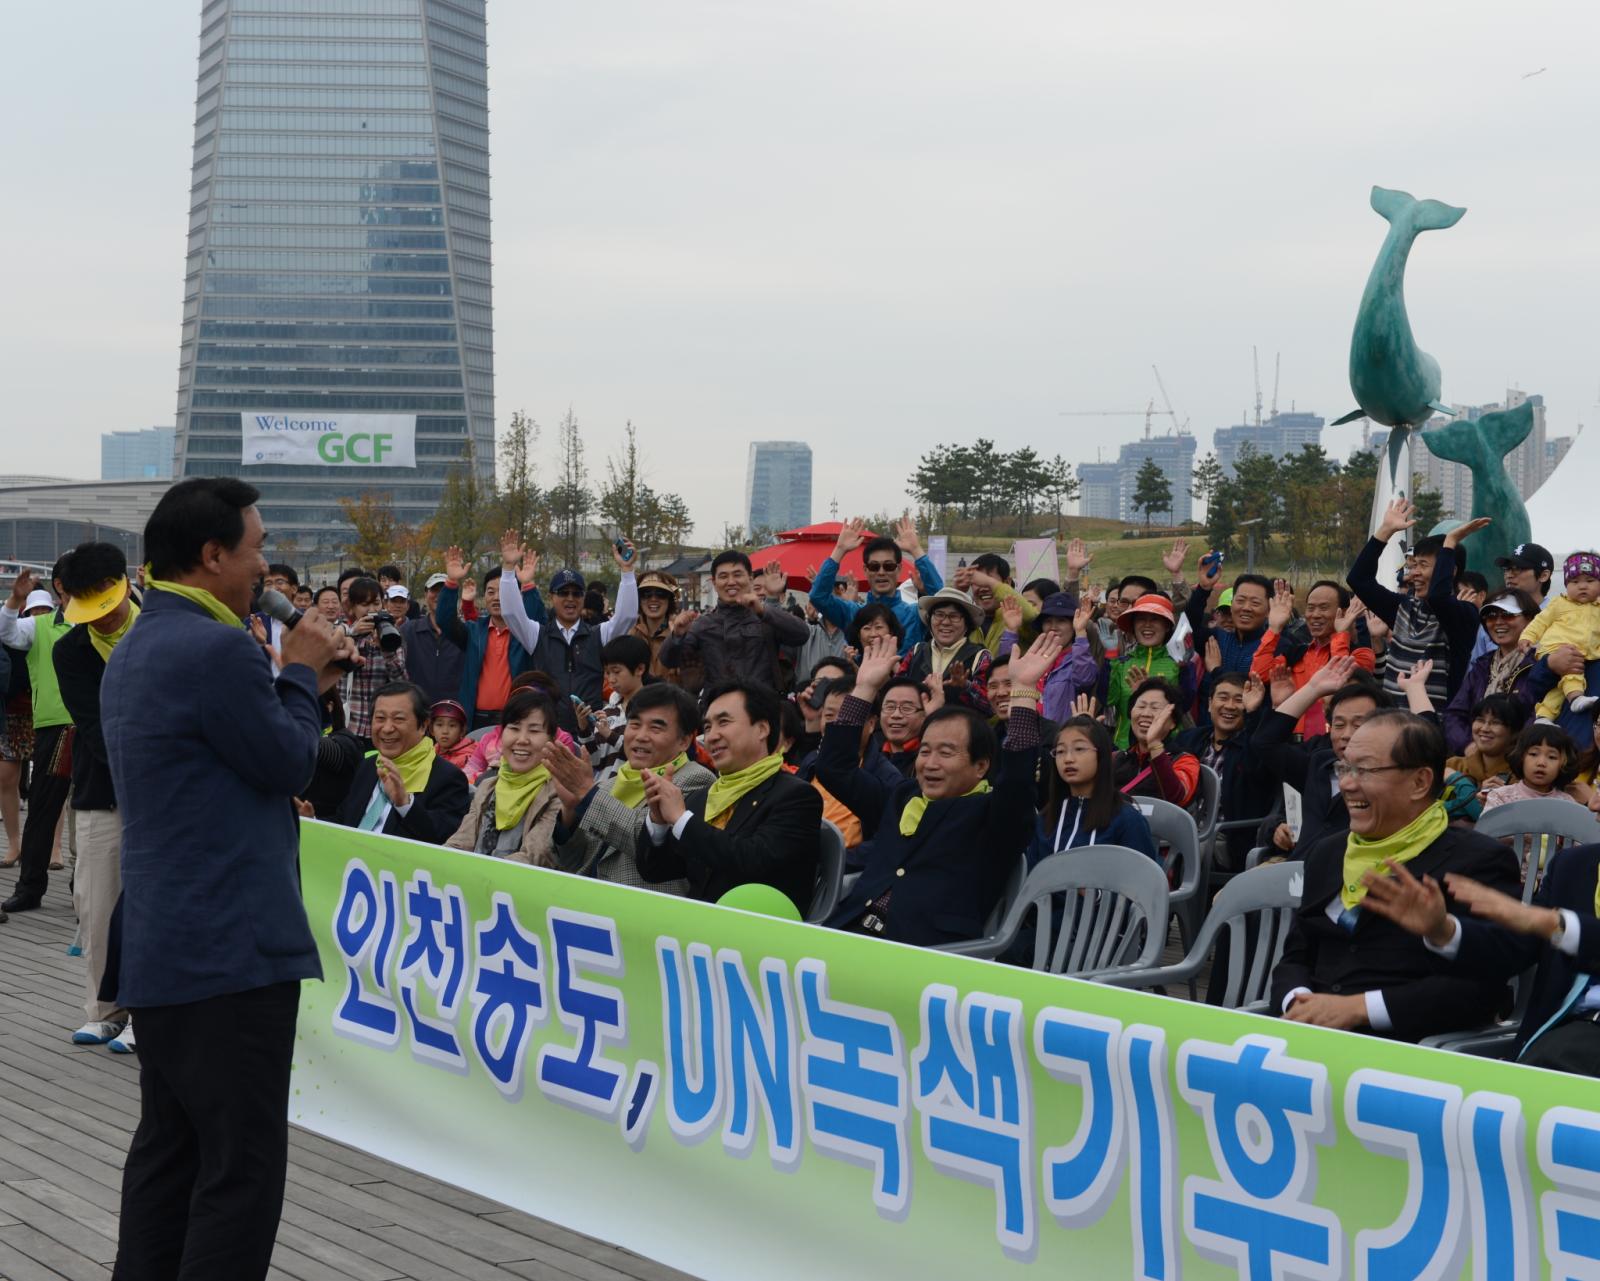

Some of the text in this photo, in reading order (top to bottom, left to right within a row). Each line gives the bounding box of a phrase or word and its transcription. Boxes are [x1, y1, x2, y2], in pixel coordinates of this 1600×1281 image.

[255, 416, 337, 432] Welcome
[317, 432, 393, 464] GCF
[334, 866, 654, 1132] 인천송도,
